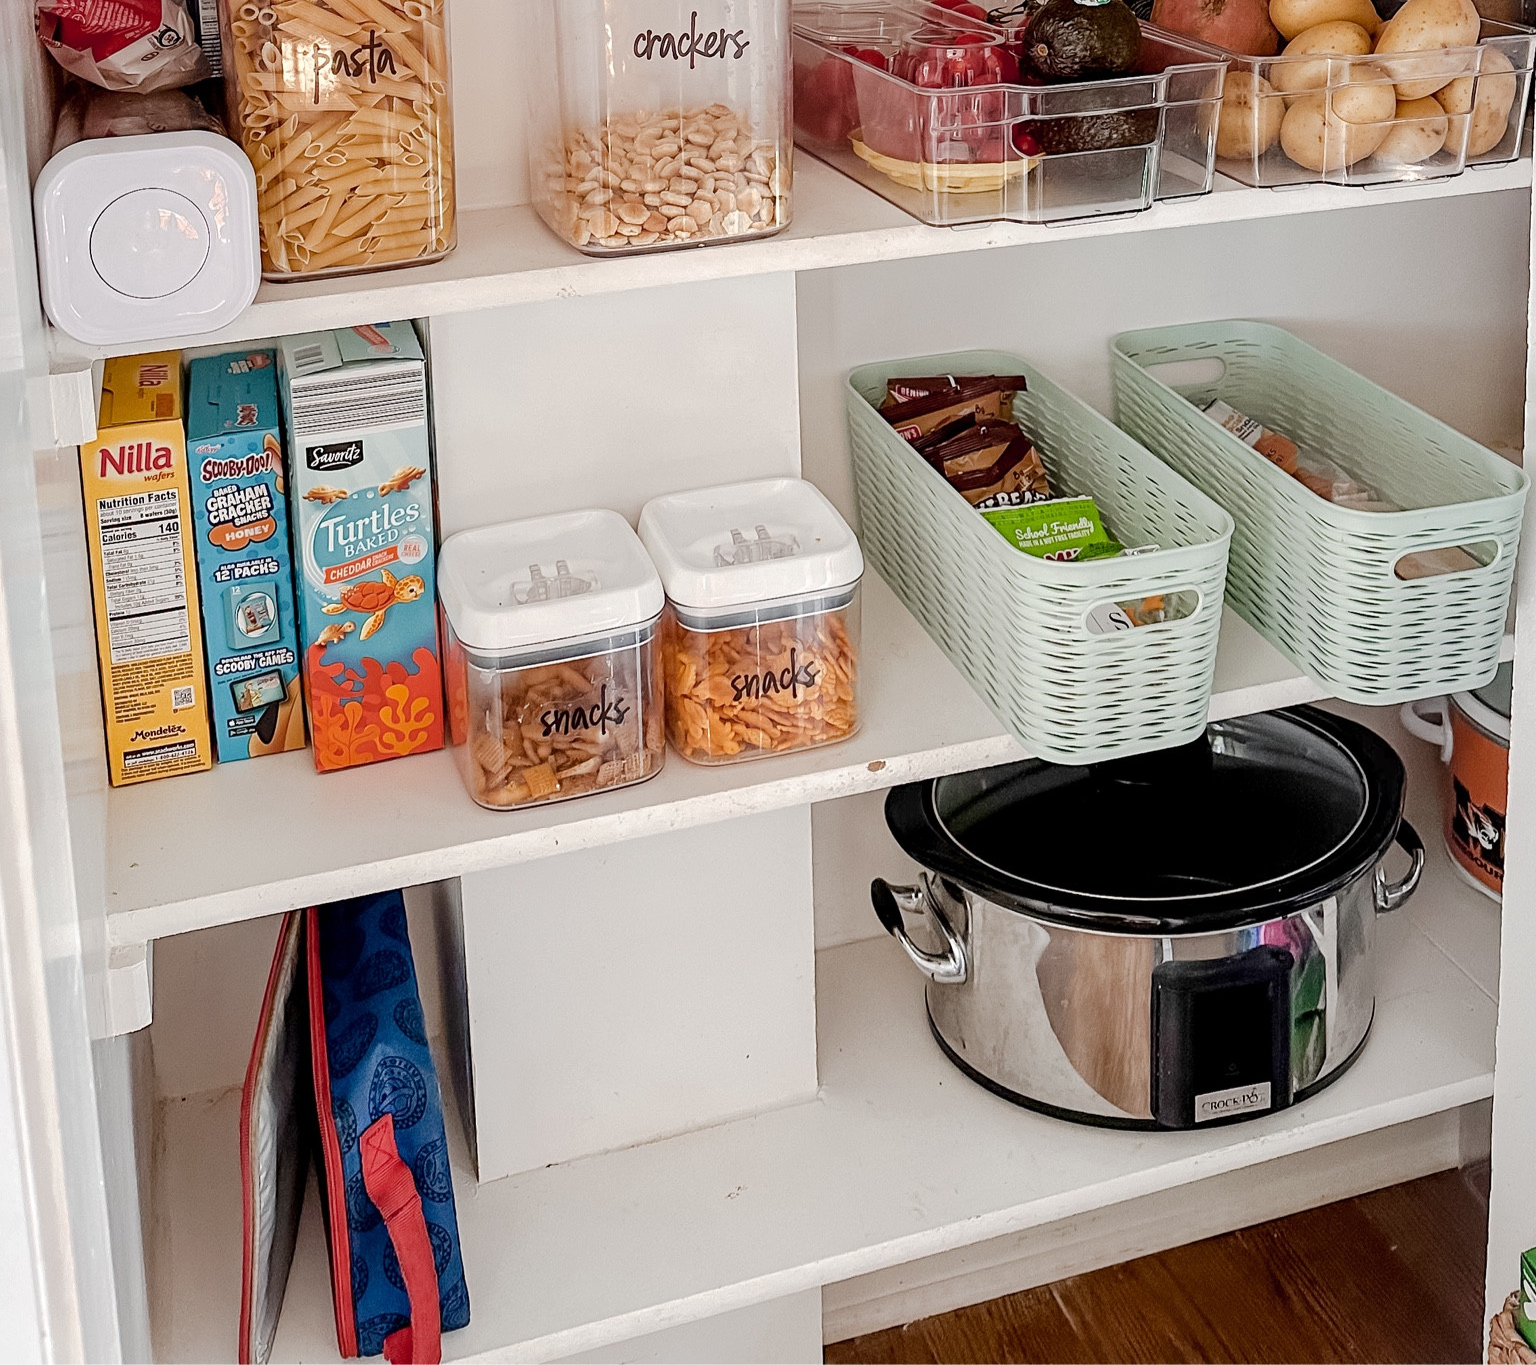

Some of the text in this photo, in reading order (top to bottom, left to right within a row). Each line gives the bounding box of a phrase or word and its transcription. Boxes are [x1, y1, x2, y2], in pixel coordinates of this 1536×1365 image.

[634, 11, 750, 70] crackers
[312, 29, 397, 105] pasta
[139, 365, 168, 388] Nilla
[99, 442, 172, 478] Nilla
[311, 443, 361, 468] Savoritz
[144, 471, 175, 482] wafers
[202, 453, 272, 482] SCOOBY-DOO!
[99, 491, 177, 510] Nutrition Facts
[207, 484, 268, 512] GRAHAM
[213, 485, 238, 498] BAKED
[209, 496, 272, 524] CRACKER
[235, 510, 268, 526] SNACKS
[102, 522, 179, 543] Calories 140
[225, 524, 270, 542] HONEY
[320, 503, 420, 552] Turtles
[1015, 517, 1095, 540] School Friendly
[345, 529, 399, 558] BAKED
[403, 543, 421, 552] REAL
[1019, 530, 1091, 548] MADE IN NUT FREE FACILITY
[372, 551, 388, 562] SNACK
[372, 554, 394, 567] CRACKERS
[215, 561, 278, 582] 12 PACKS
[330, 558, 372, 580] CHEDDAR
[1108, 612, 1130, 632] S
[216, 652, 294, 675] SCOOBY GAMES
[222, 654, 252, 664] DOWNLOAD
[731, 647, 820, 702] snacks
[541, 685, 630, 736] snacks
